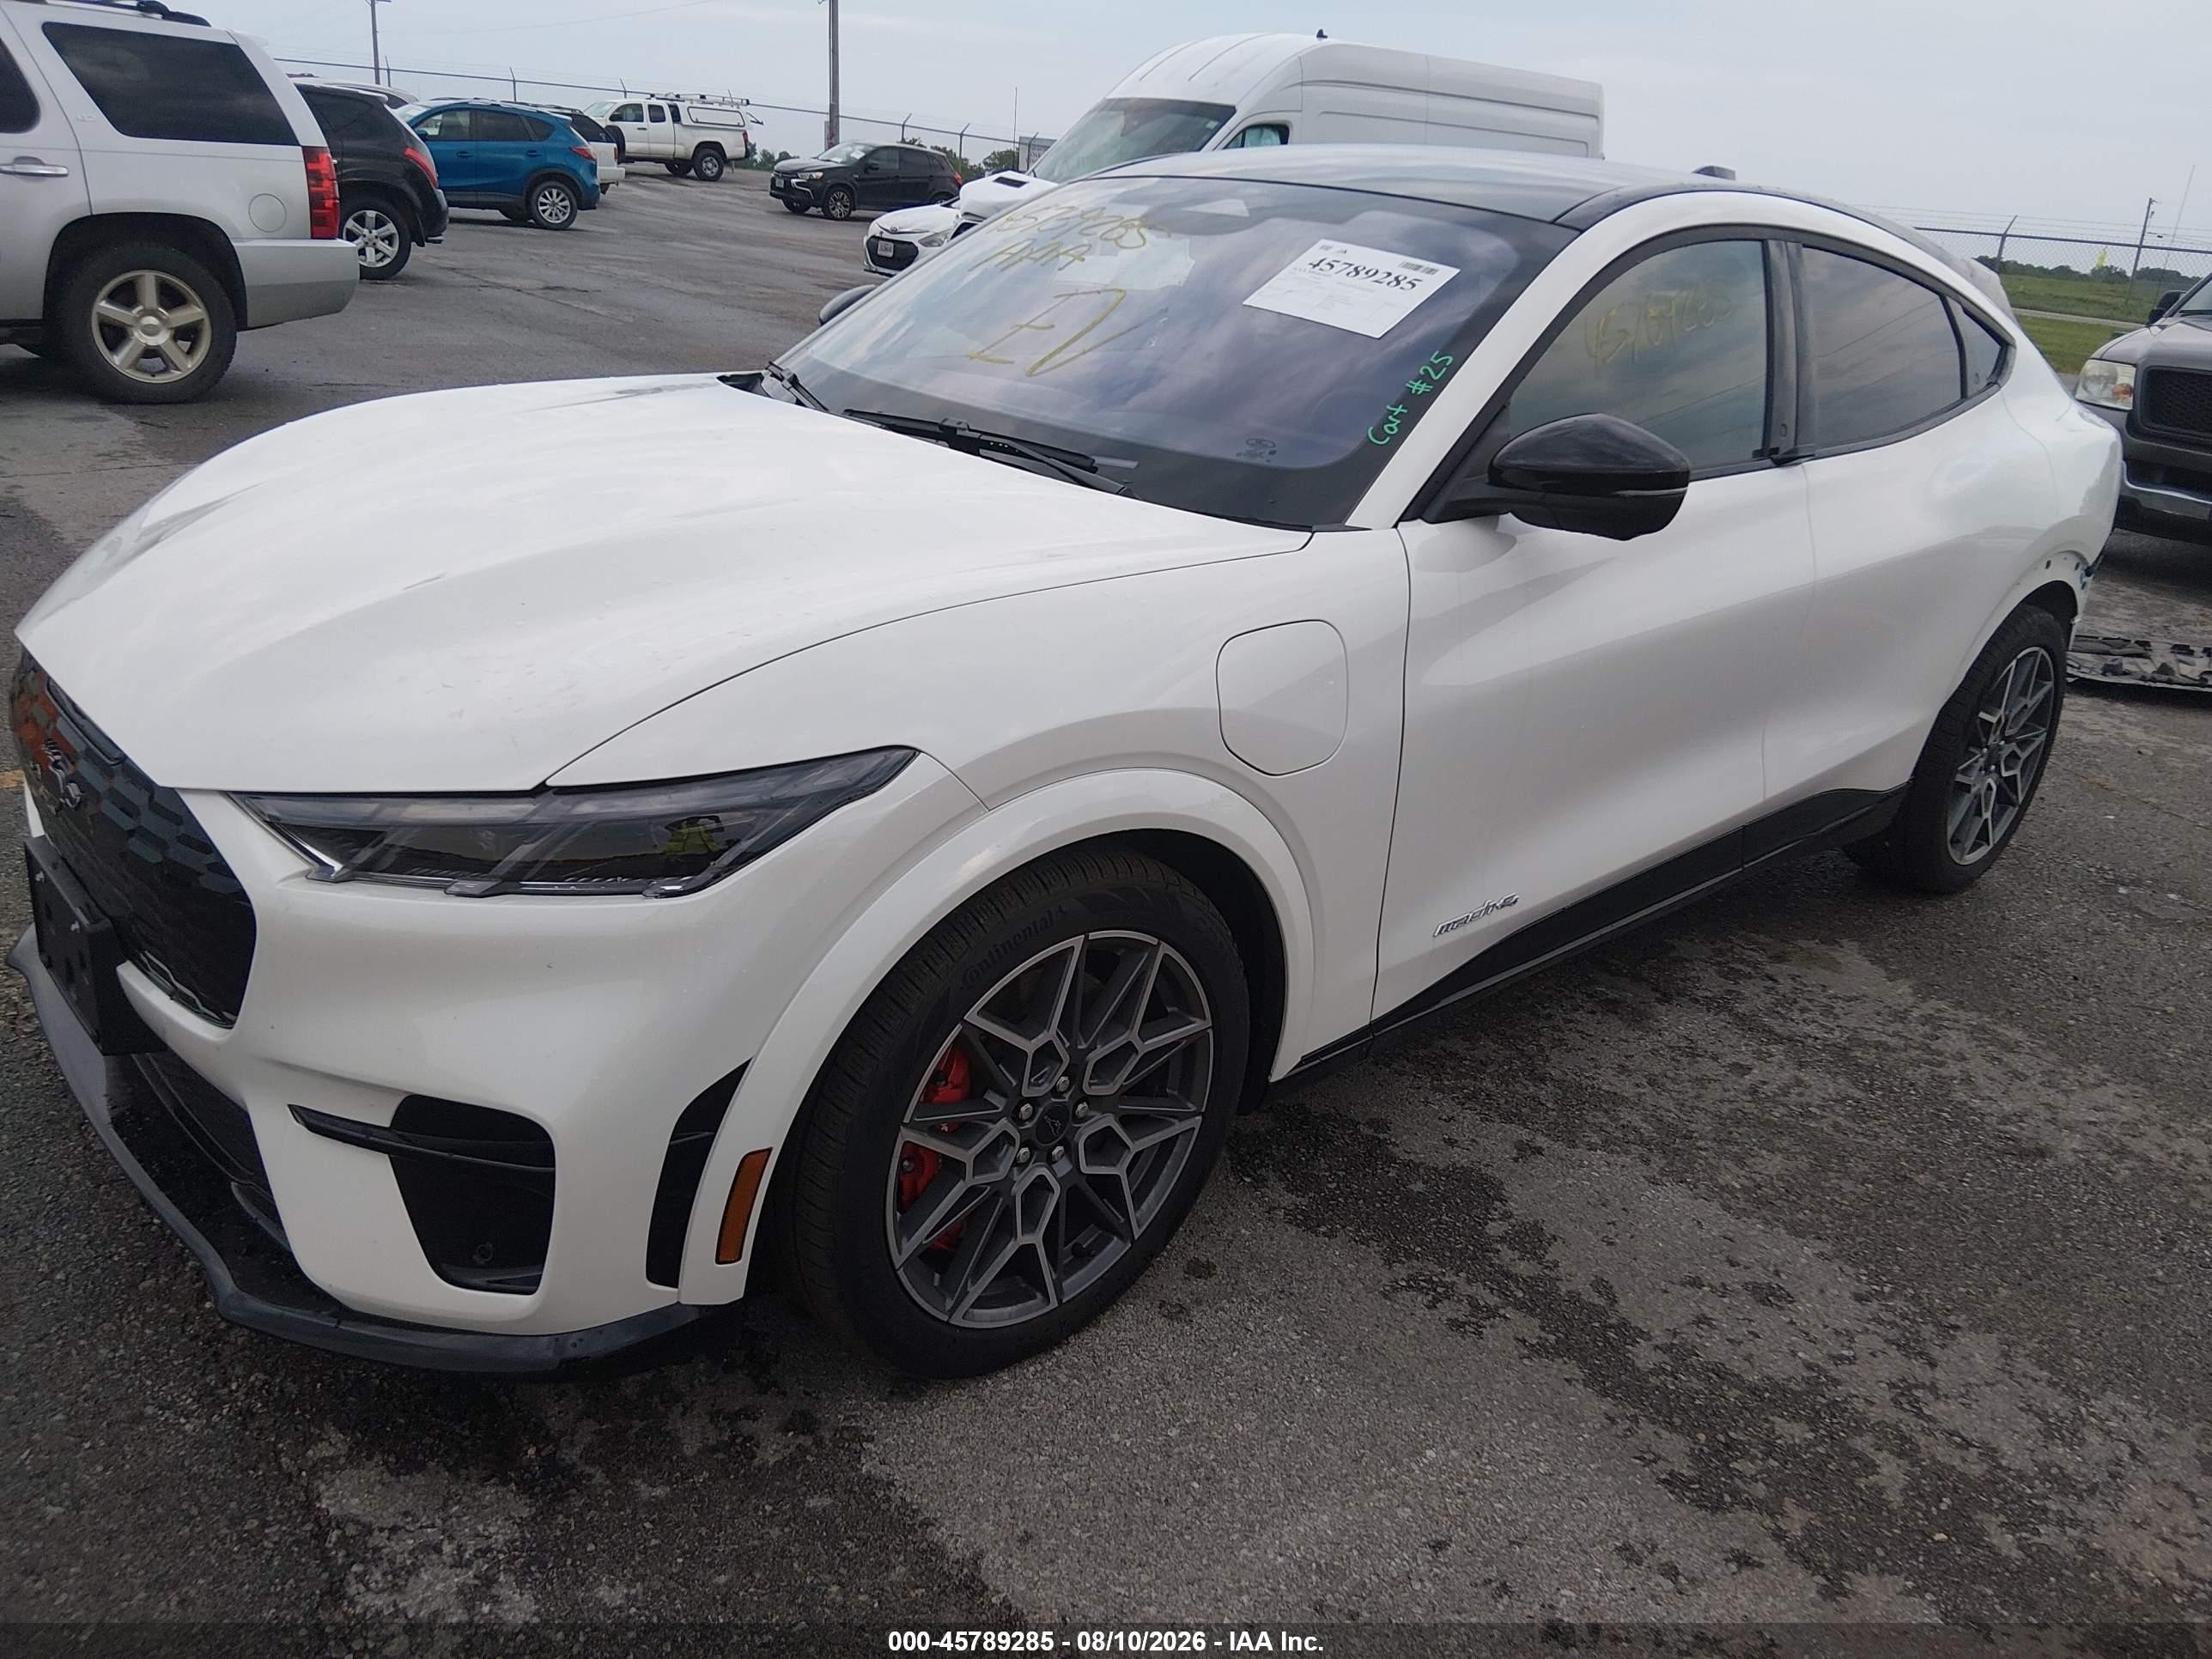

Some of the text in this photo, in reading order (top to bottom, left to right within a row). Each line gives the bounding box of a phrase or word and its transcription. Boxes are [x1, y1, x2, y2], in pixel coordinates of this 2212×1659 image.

[1307, 257, 1423, 291] 45789285
[1367, 349, 1454, 445] Cart #25
